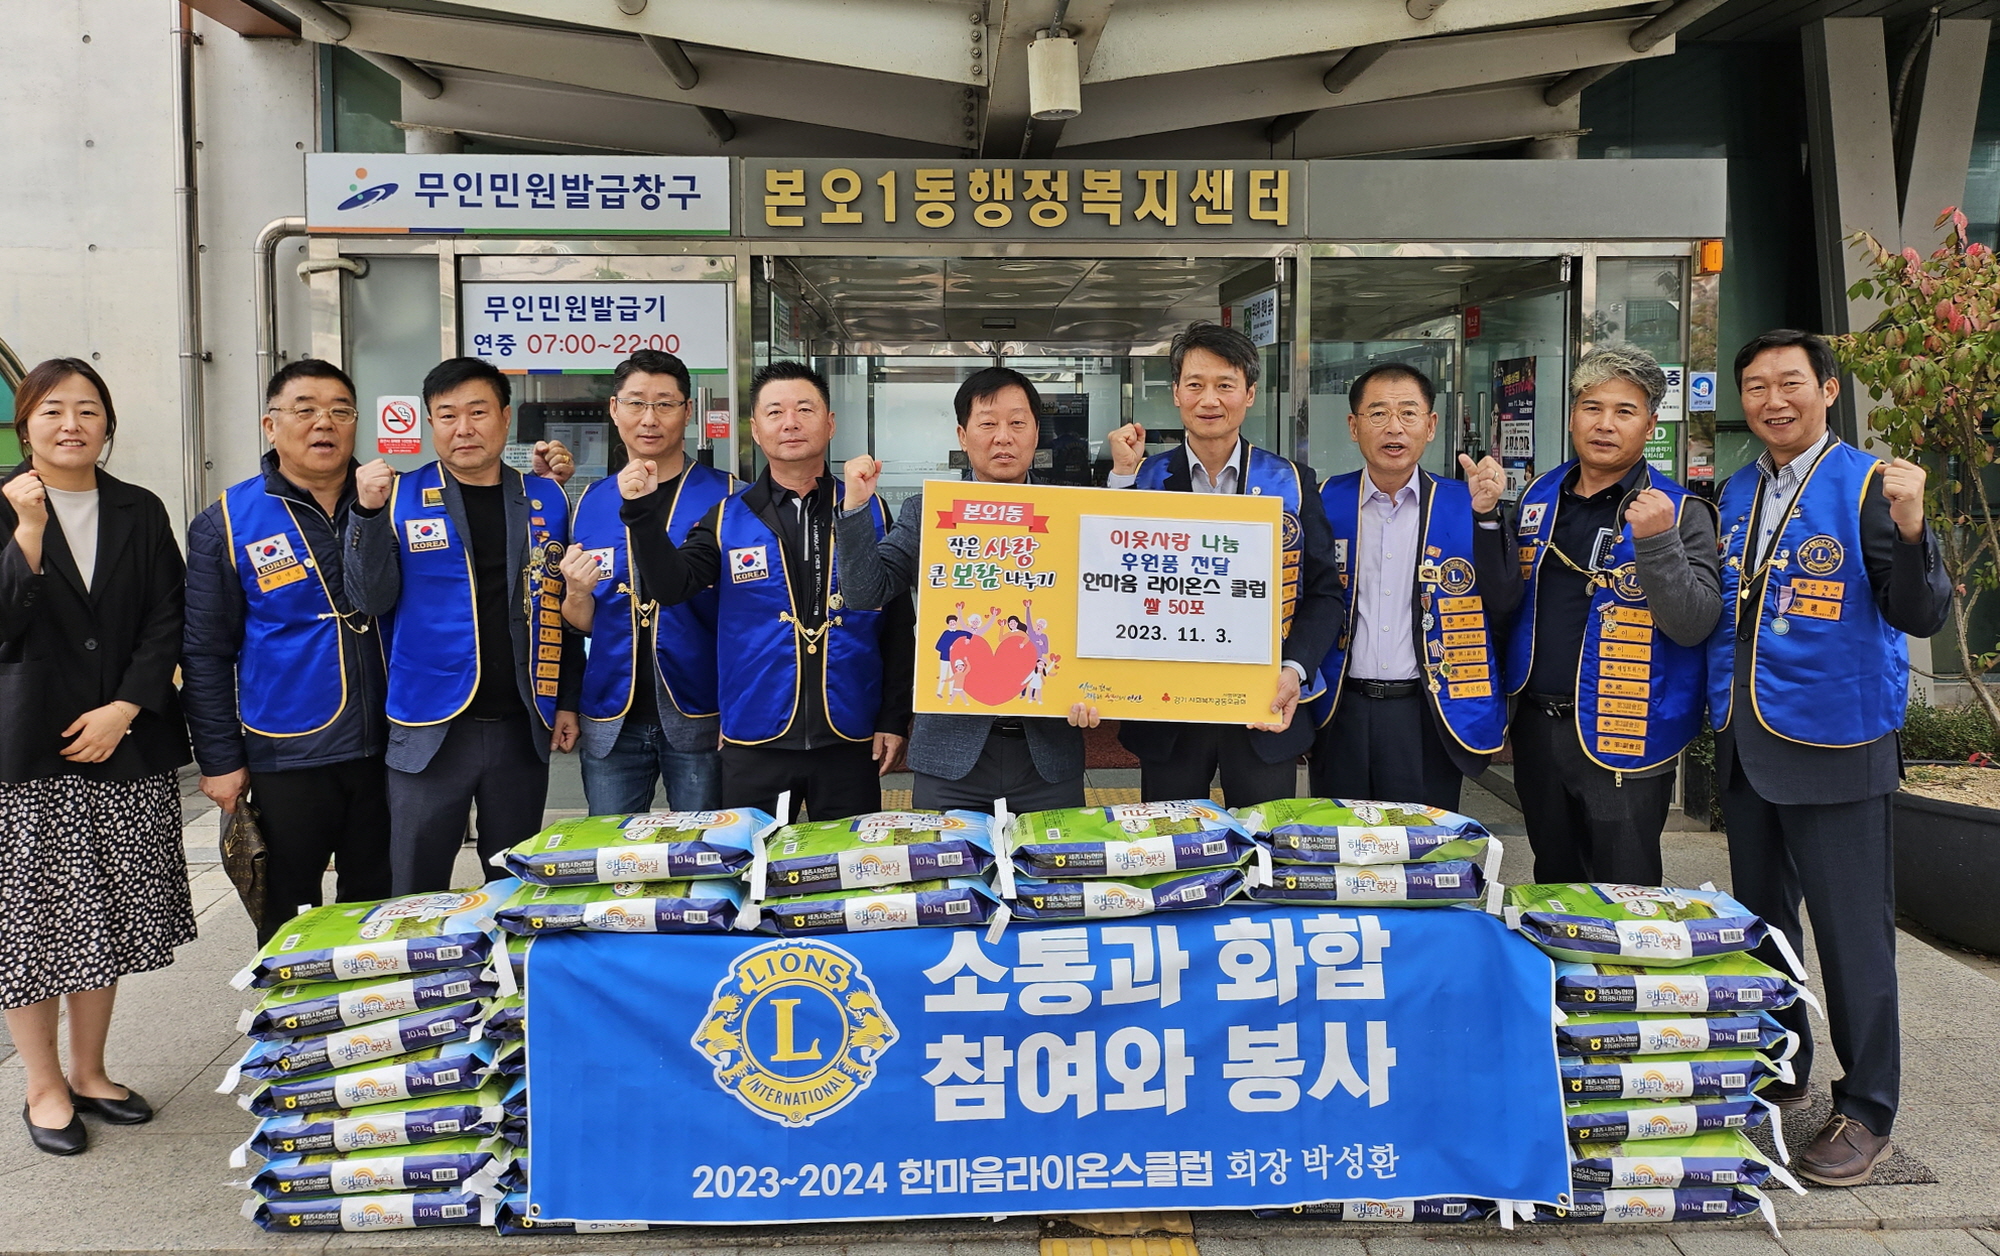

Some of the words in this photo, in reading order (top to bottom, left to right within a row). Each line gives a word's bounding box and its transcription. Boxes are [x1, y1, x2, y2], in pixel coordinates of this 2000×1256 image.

[414, 172, 702, 210] 무인민원발급창구
[764, 168, 1290, 228] 본오1동행정복지센터
[484, 295, 667, 323] 무인민원발급기
[474, 334, 516, 356] 연중
[527, 334, 680, 354] 07:00~22:00
[963, 503, 1024, 522] 본오1동
[412, 540, 446, 550] KOREA
[1111, 530, 1190, 552] 이웃사랑
[1202, 534, 1240, 554] 나눔
[1812, 540, 1833, 548] LIONS
[948, 536, 980, 559] 작은
[984, 536, 1039, 568] 사랑
[1815, 548, 1826, 560] L
[260, 556, 294, 574] KOREA
[1121, 553, 1179, 575] 후원품
[1191, 556, 1231, 576] 전달
[736, 570, 766, 580] KOREA
[928, 564, 947, 588] 큰
[952, 563, 1002, 590] 보람
[1005, 571, 1056, 591] 나누기
[1451, 570, 1460, 582] L
[1628, 574, 1638, 587] L
[1083, 572, 1138, 594] 한마음
[1147, 576, 1221, 596] 라이온스
[1231, 579, 1267, 598] 클럽
[1144, 598, 1161, 615] 쌀
[1168, 599, 1206, 615] 50포
[1116, 624, 1167, 641] 2023.
[1178, 627, 1206, 642] 11.
[1216, 628, 1232, 644] 3.
[1174, 696, 1187, 704] 경기
[1181, 846, 1190, 856] 10
[1190, 846, 1201, 858] kg
[1347, 839, 1377, 856] 행복한
[1378, 840, 1400, 854] 햇살
[606, 859, 636, 876] 행복한
[638, 859, 660, 874] 햇살
[674, 855, 683, 864] 10
[684, 855, 695, 866] kg
[916, 856, 924, 866] 10
[926, 856, 936, 868] kg
[1114, 852, 1144, 870] 행복한
[1144, 852, 1167, 867] 햇살
[848, 862, 878, 880] 행복한
[880, 862, 902, 876] 햇살
[1345, 877, 1376, 895] 행복한
[1376, 879, 1398, 894] 햇살
[1412, 876, 1421, 885] 10
[1422, 876, 1432, 886] kg
[1094, 894, 1124, 911] 행복한
[1124, 896, 1146, 910] 햇살
[1160, 894, 1168, 903] 10
[1169, 892, 1180, 904] kg
[661, 912, 670, 921] 10
[671, 912, 682, 922] kg
[854, 908, 885, 926] 행복한
[886, 911, 908, 924] 햇살
[923, 904, 932, 914] 10
[933, 904, 944, 915] kg
[593, 913, 624, 930] 행복한
[626, 914, 646, 928] 햇살
[1627, 932, 1660, 950] 행복한
[1660, 934, 1682, 951] 햇살
[1696, 931, 1704, 941] 10
[1706, 931, 1718, 943] kg
[413, 951, 422, 960] 10
[424, 950, 435, 961] kg
[342, 957, 375, 975] 행복한
[376, 956, 399, 970] 햇살
[747, 954, 846, 987] LIONS
[923, 924, 1190, 1016] 소통과
[1214, 914, 1391, 1006] 화합
[420, 989, 430, 999] 10
[430, 988, 442, 999] kg
[1645, 988, 1678, 1008] 행복한
[1678, 990, 1699, 1006] 햇살
[1714, 990, 1723, 1000] 10
[1724, 990, 1735, 1002] kg
[349, 1002, 382, 1019] 행복한
[383, 998, 406, 1012] 햇살
[406, 1029, 416, 1039] 10
[417, 1028, 428, 1040] kg
[769, 998, 822, 1063] L
[1714, 1032, 1723, 1041] 10
[1724, 1032, 1735, 1042] kg
[338, 1043, 370, 1060] 행복한
[371, 1039, 393, 1053] 햇살
[1648, 1034, 1680, 1051] 행복한
[1680, 1036, 1700, 1050] 햇살
[921, 1026, 1196, 1122] 참여와
[1222, 1020, 1397, 1113] 봉사
[412, 1077, 421, 1086] 10
[422, 1076, 433, 1087] kg
[1631, 1078, 1662, 1095] 행복한
[1663, 1080, 1684, 1094] 햇살
[1708, 1076, 1720, 1087] kg
[345, 1086, 376, 1102] 행복한
[377, 1083, 398, 1098] 햇살
[746, 1074, 847, 1107] INTERNATIONAL
[1637, 1123, 1666, 1139] 행복한
[1668, 1123, 1688, 1137] 햇살
[1703, 1118, 1712, 1127] 10
[1712, 1117, 1722, 1128] kg
[343, 1132, 374, 1148] 행복한
[376, 1130, 398, 1143] 햇살
[409, 1171, 418, 1180] 10
[420, 1171, 431, 1181] kg
[692, 1163, 888, 1199] 2023~2024
[898, 1149, 1214, 1195] 한마음라이온스클럽
[1226, 1148, 1291, 1187] 회장
[1301, 1144, 1400, 1180] 박성환
[1621, 1172, 1652, 1187] 행복한
[1690, 1172, 1700, 1180] 10
[1700, 1172, 1710, 1182] kg
[340, 1176, 372, 1190] 행복한
[418, 1208, 428, 1218] 10
[428, 1208, 440, 1218] kg
[1352, 1202, 1383, 1218] 행복한
[1384, 1206, 1405, 1218] 햇살
[1421, 1204, 1430, 1213] 10
[1430, 1204, 1441, 1214] kg
[1614, 1204, 1644, 1218] 행복한
[1645, 1204, 1666, 1219] 햇살
[1682, 1202, 1690, 1210] 10
[1690, 1202, 1702, 1212] kg
[350, 1210, 382, 1228] 행복한
[382, 1210, 404, 1225] 햇살
